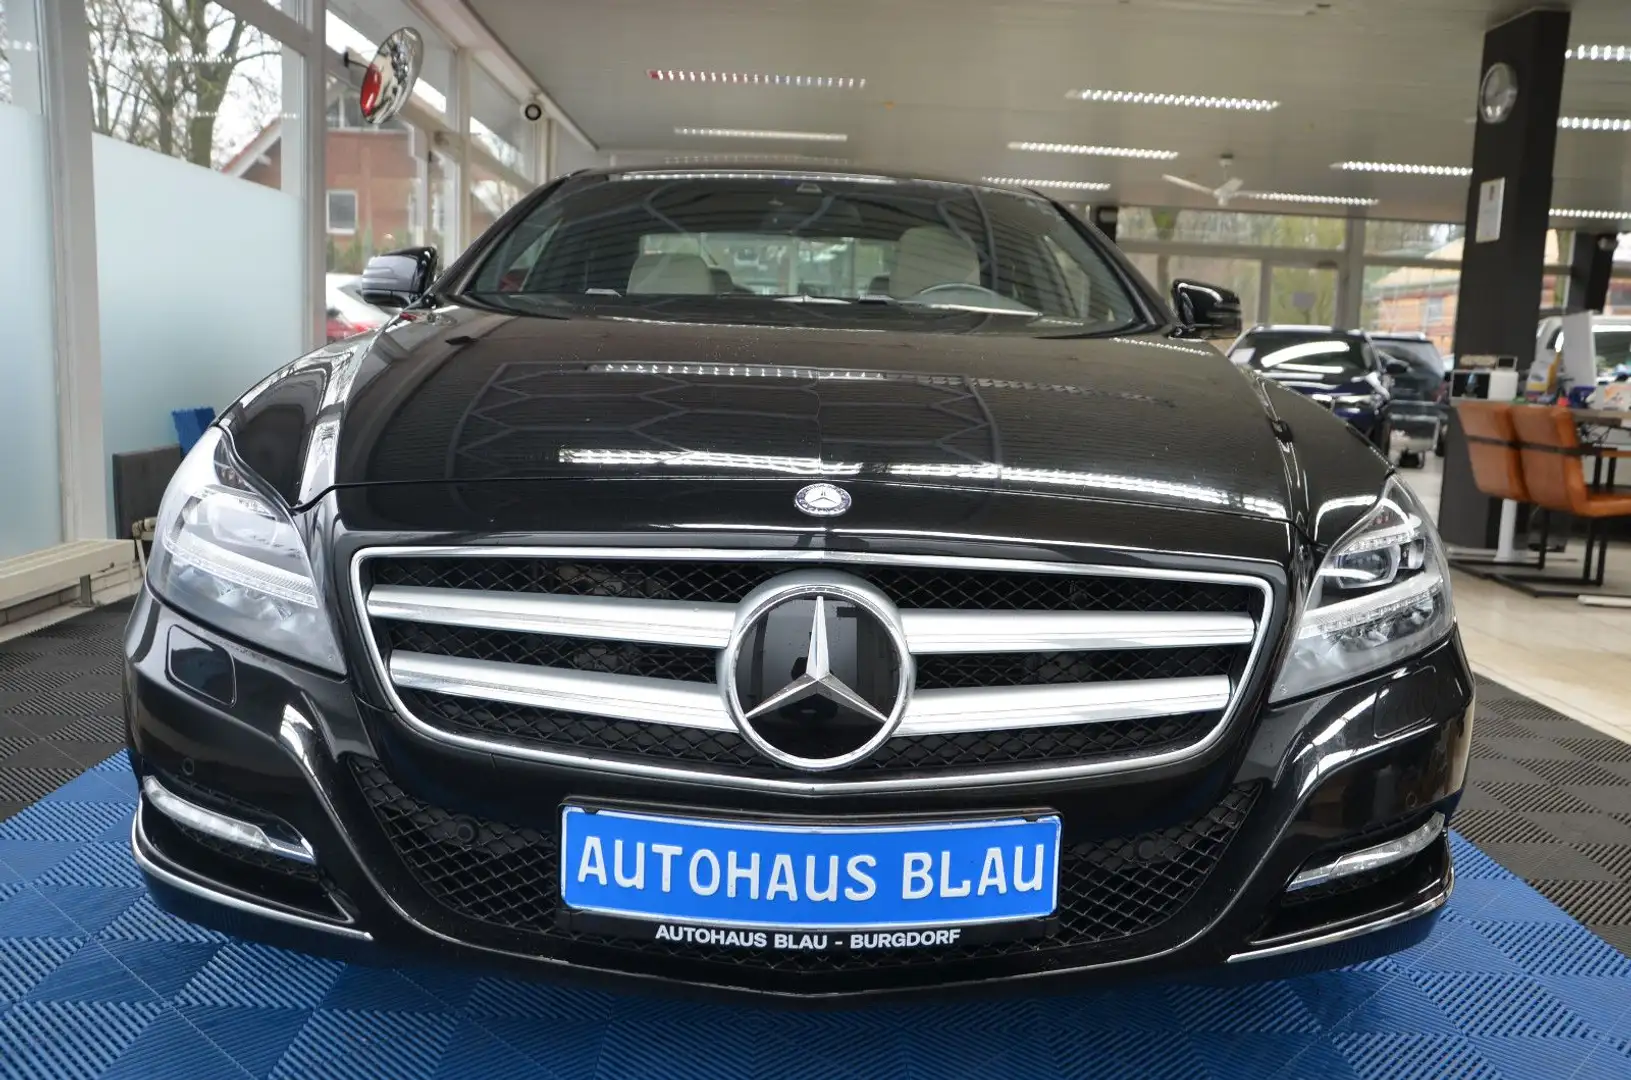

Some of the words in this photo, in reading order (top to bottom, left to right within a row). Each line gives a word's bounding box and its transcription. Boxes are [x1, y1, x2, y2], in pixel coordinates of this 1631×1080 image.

[577, 835, 878, 902] AUTOHAUS
[901, 843, 1045, 900] BLAU
[655, 924, 767, 949] AUTOHAUS
[774, 933, 828, 950] BLAU
[850, 928, 961, 949] BURGDORF
